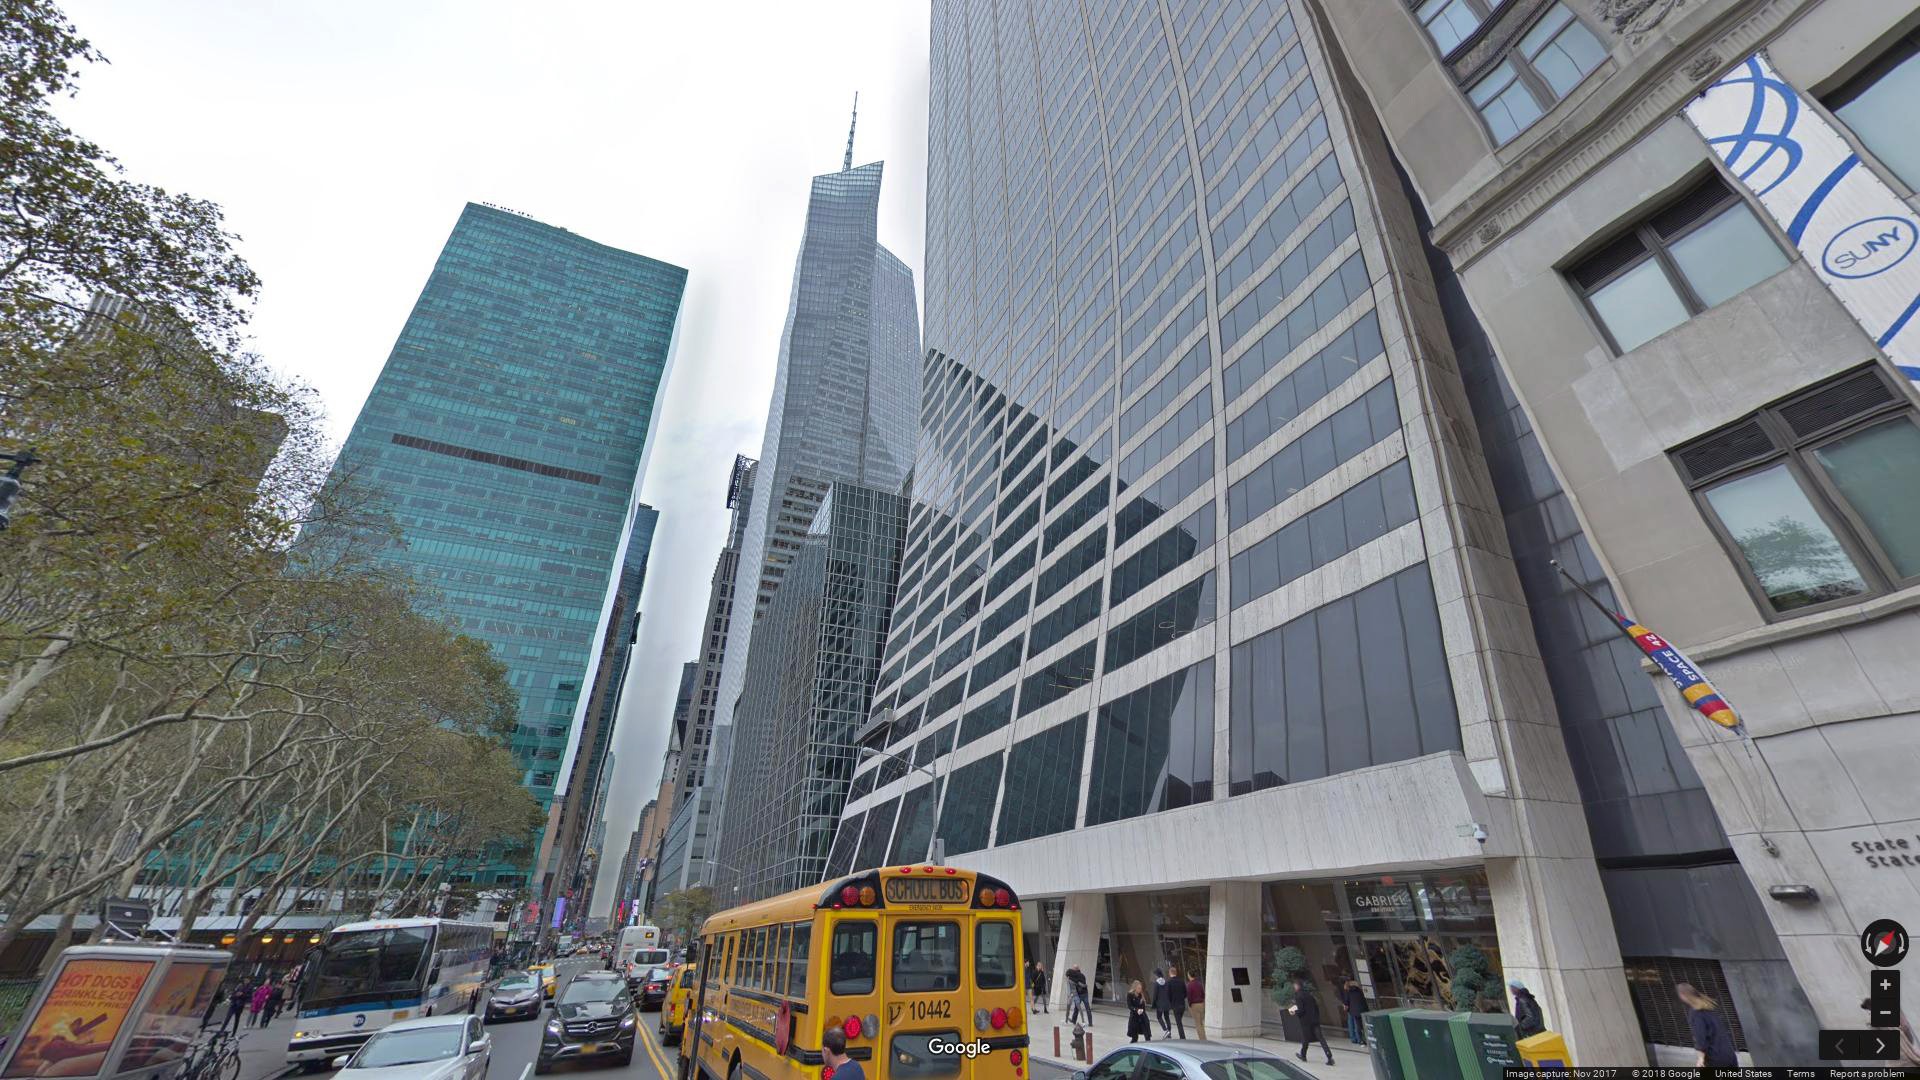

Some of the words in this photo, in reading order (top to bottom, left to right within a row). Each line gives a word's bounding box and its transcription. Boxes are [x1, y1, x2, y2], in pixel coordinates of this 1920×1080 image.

[1834, 226, 1900, 270] SUNY
[1645, 634, 1662, 647] 42
[1661, 650, 1699, 681] SPACE
[1851, 838, 1909, 854] State
[888, 879, 937, 900] SCHOOL
[940, 879, 963, 900] BUS
[61, 973, 93, 987] HOT
[92, 974, 131, 989] DOGS
[910, 1000, 951, 1020] 10442
